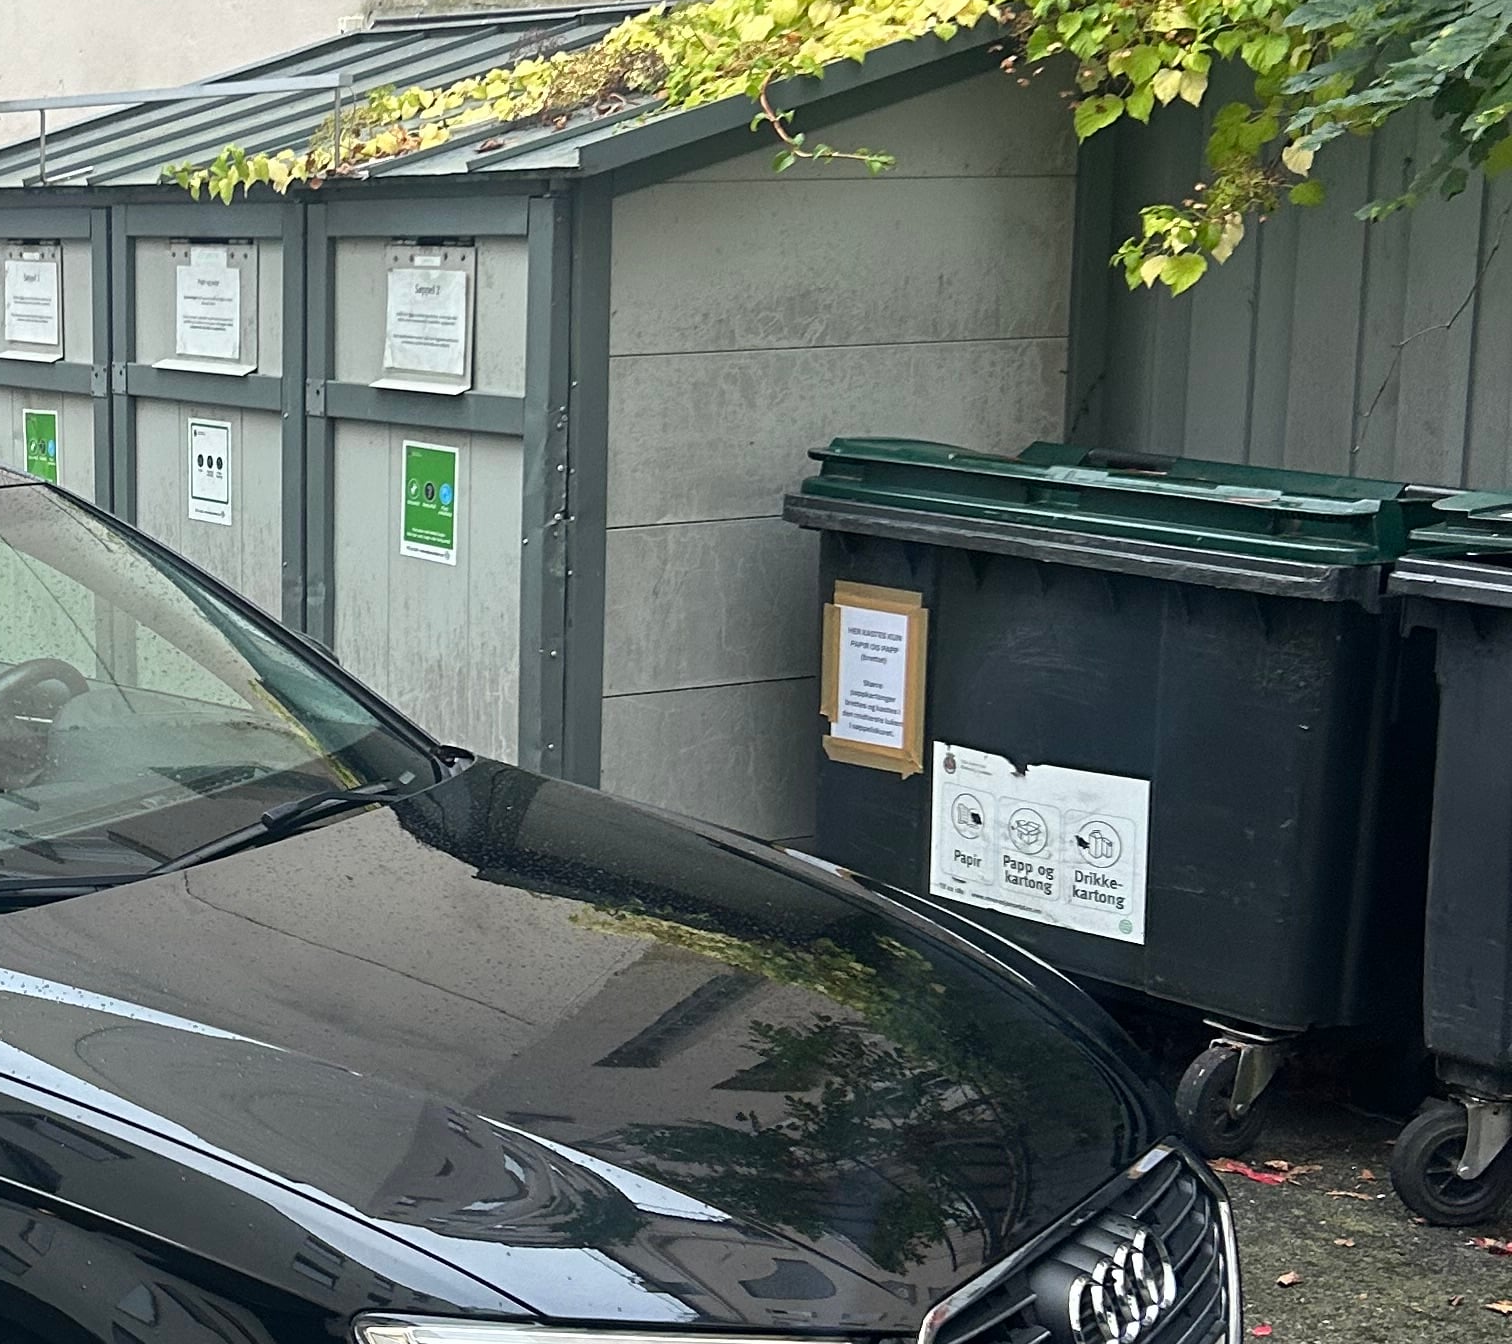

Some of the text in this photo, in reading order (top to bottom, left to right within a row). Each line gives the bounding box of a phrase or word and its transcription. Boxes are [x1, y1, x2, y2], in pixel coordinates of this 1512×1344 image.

[953, 849, 983, 868] Papir
[1003, 855, 1055, 881] Papp og
[1004, 871, 1053, 896] kartong
[1074, 870, 1124, 890] Drikke-
[1072, 885, 1126, 910] kartong
